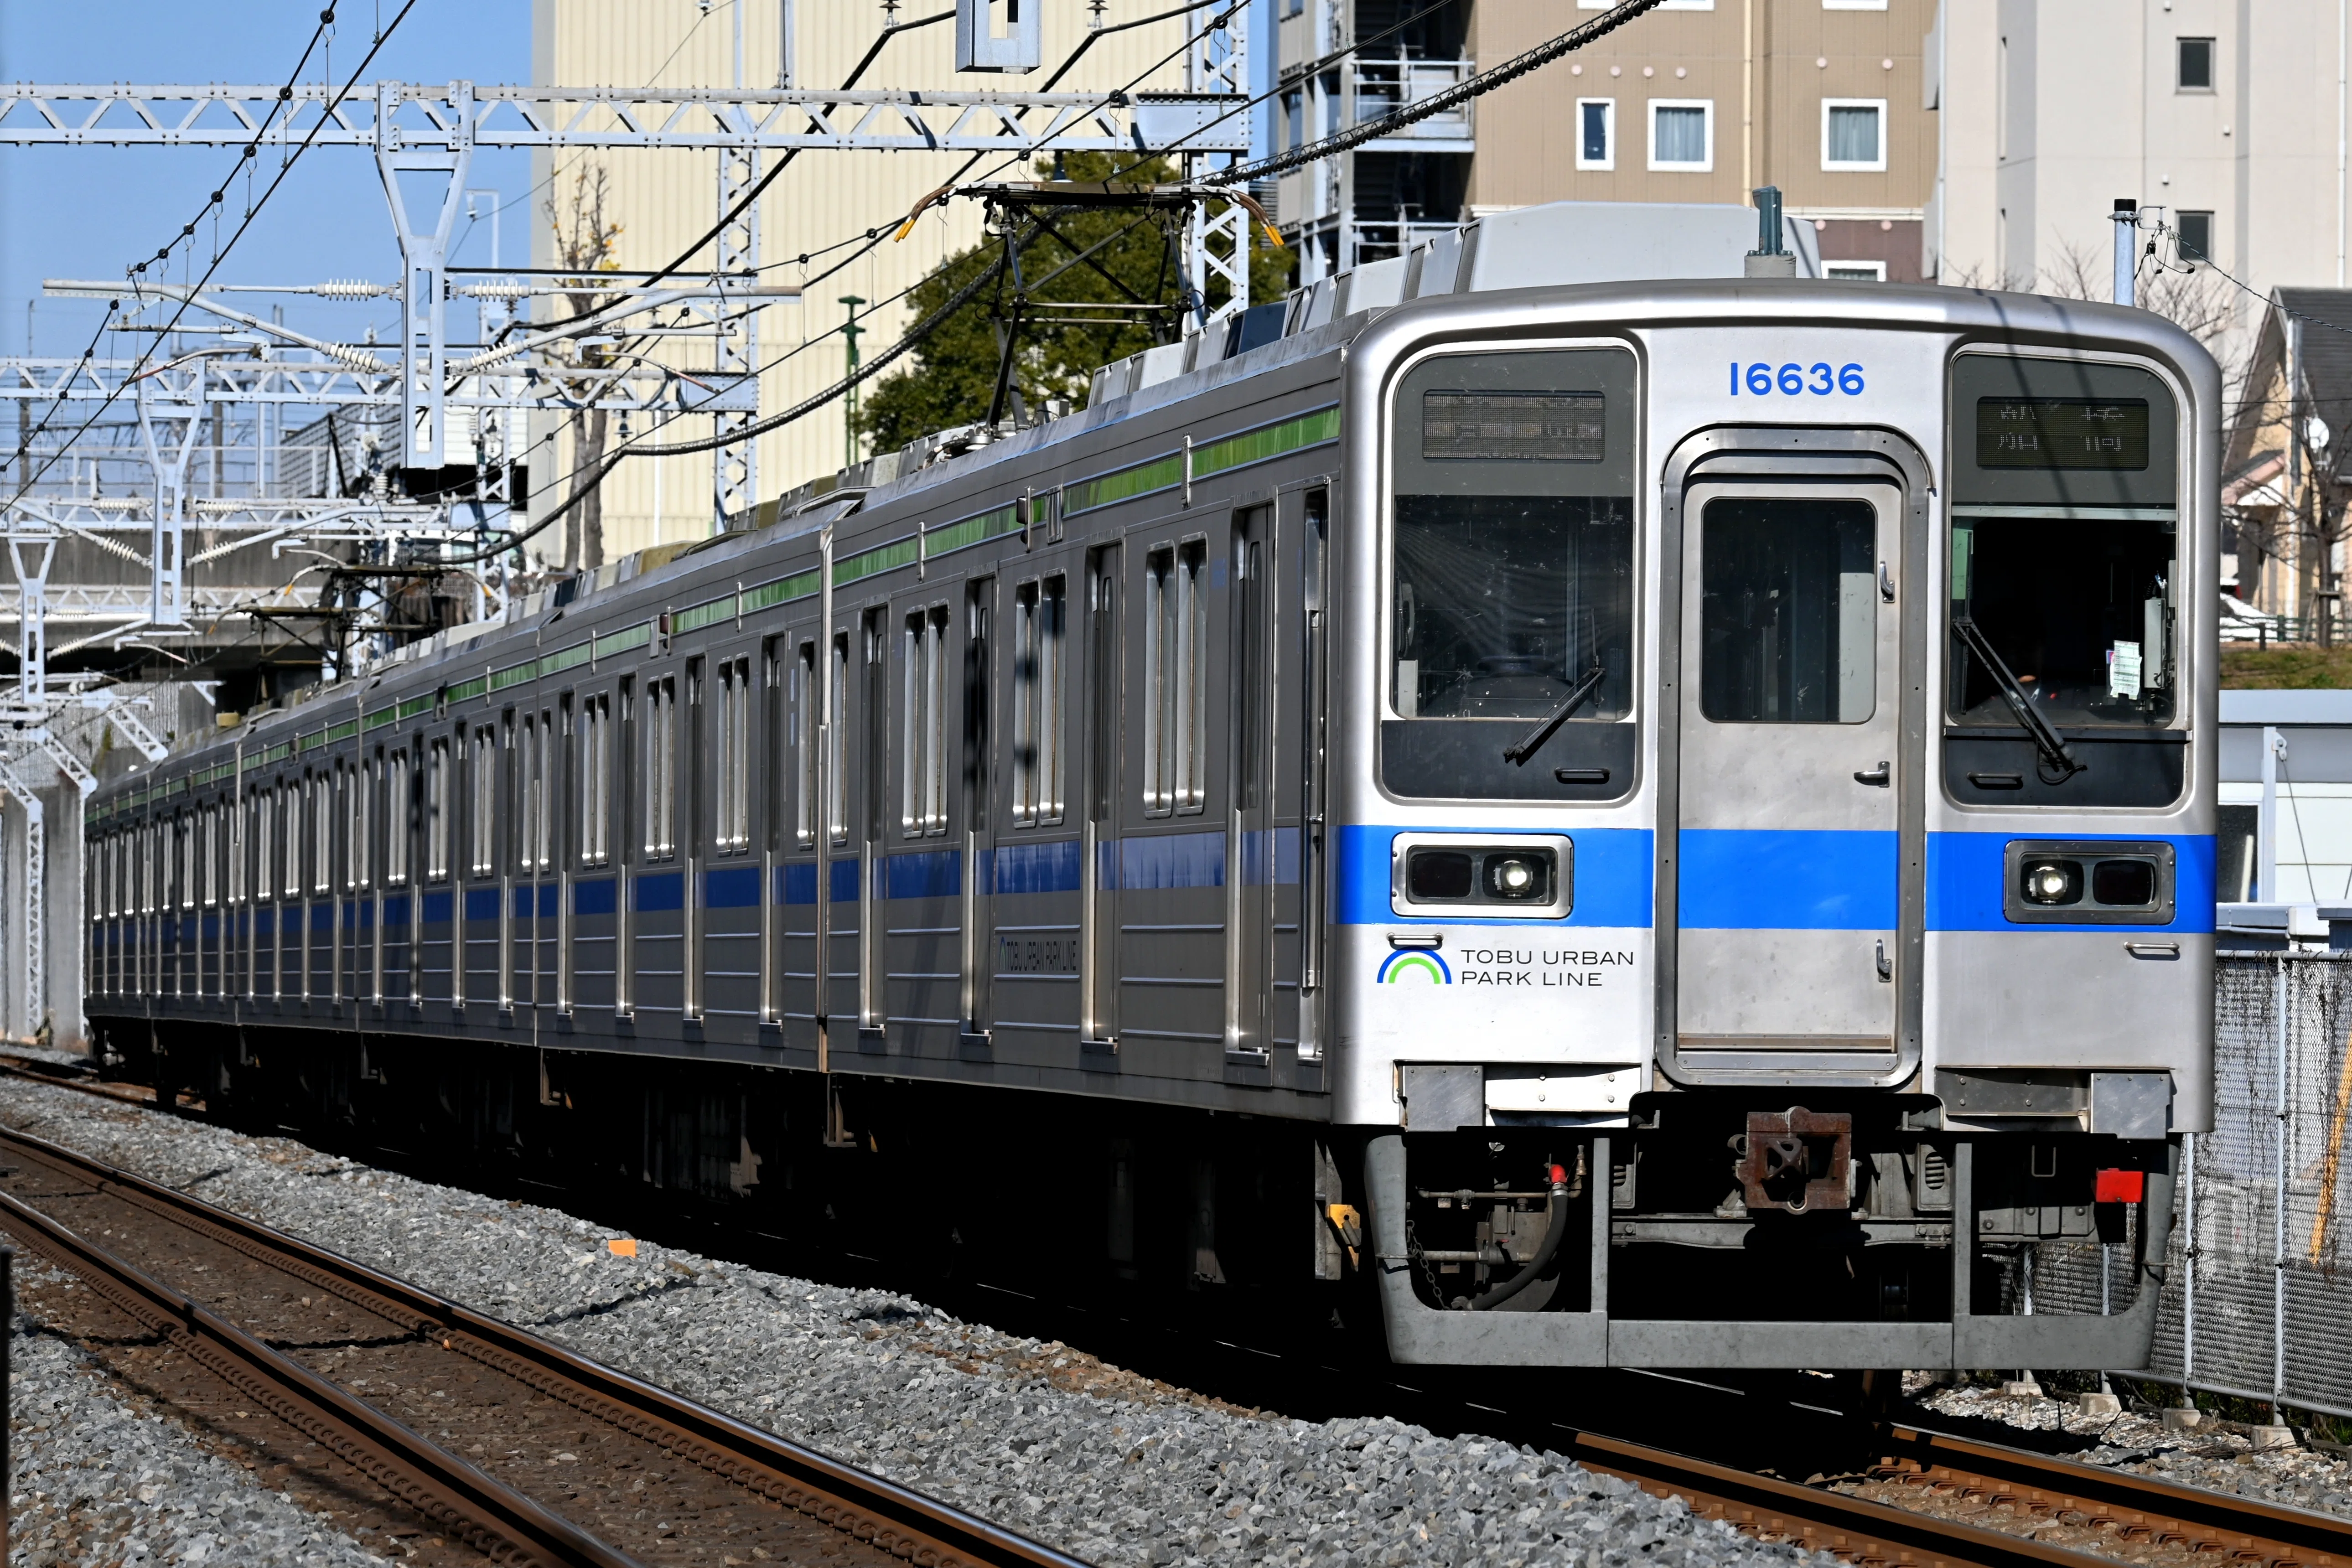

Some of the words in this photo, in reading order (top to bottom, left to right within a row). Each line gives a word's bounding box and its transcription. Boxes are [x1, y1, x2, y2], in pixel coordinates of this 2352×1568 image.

[1731, 362, 1864, 395] 16636
[1007, 941, 1022, 971] TOBU
[1461, 950, 1531, 964] TOBU
[1544, 951, 1633, 965] URBAN
[1462, 972, 1531, 985] PARK
[1544, 973, 1602, 986] LINE
